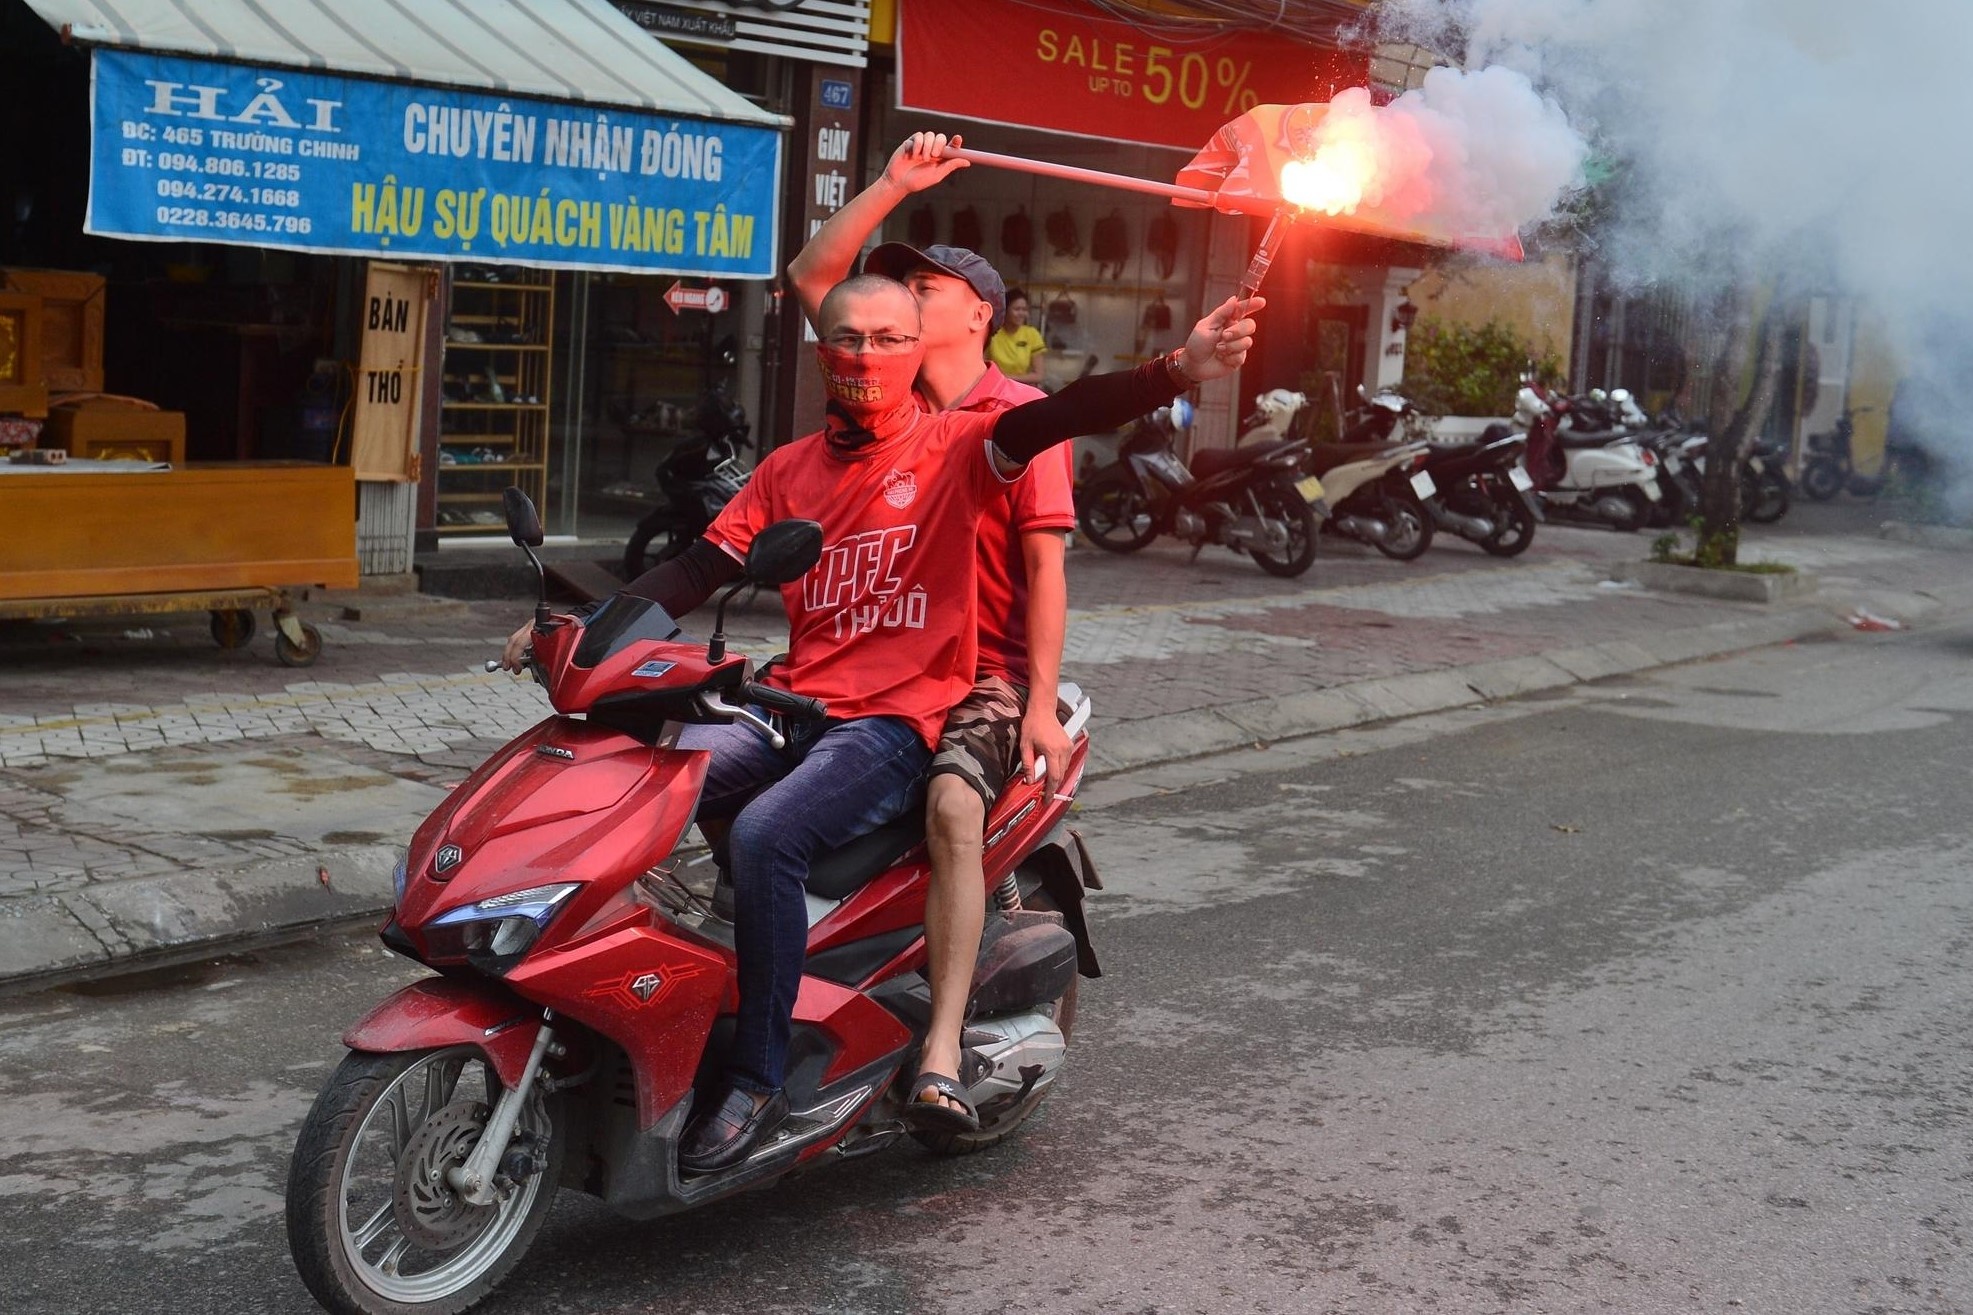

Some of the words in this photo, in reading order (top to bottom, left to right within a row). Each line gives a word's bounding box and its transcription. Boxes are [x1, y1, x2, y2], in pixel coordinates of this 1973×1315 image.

[659, 14, 680, 28] NAM
[1037, 29, 1134, 75] SALE
[824, 84, 849, 105] 467
[1088, 75, 1110, 92] UP
[1112, 79, 1132, 97] TO
[143, 77, 343, 133] HẢI
[162, 126, 203, 146] 465
[298, 139, 360, 161] CHINH
[403, 102, 534, 163] CHUYÊN
[543, 115, 633, 181] NHẬN
[640, 122, 723, 183] ĐÓNG
[818, 122, 850, 162] GIÀY
[122, 147, 153, 168] ĐT:
[158, 152, 300, 182] 094.806.1285
[157, 179, 300, 208] 094.274.1668
[815, 169, 848, 213] VIỆT
[157, 206, 312, 234] 0228.3645.796
[351, 174, 425, 246] HẬU
[433, 187, 486, 251] SỰ
[490, 187, 601, 248] QUÁCH
[608, 194, 685, 255] VÀNG
[694, 202, 756, 259] TÂM
[368, 291, 409, 333] BÀN
